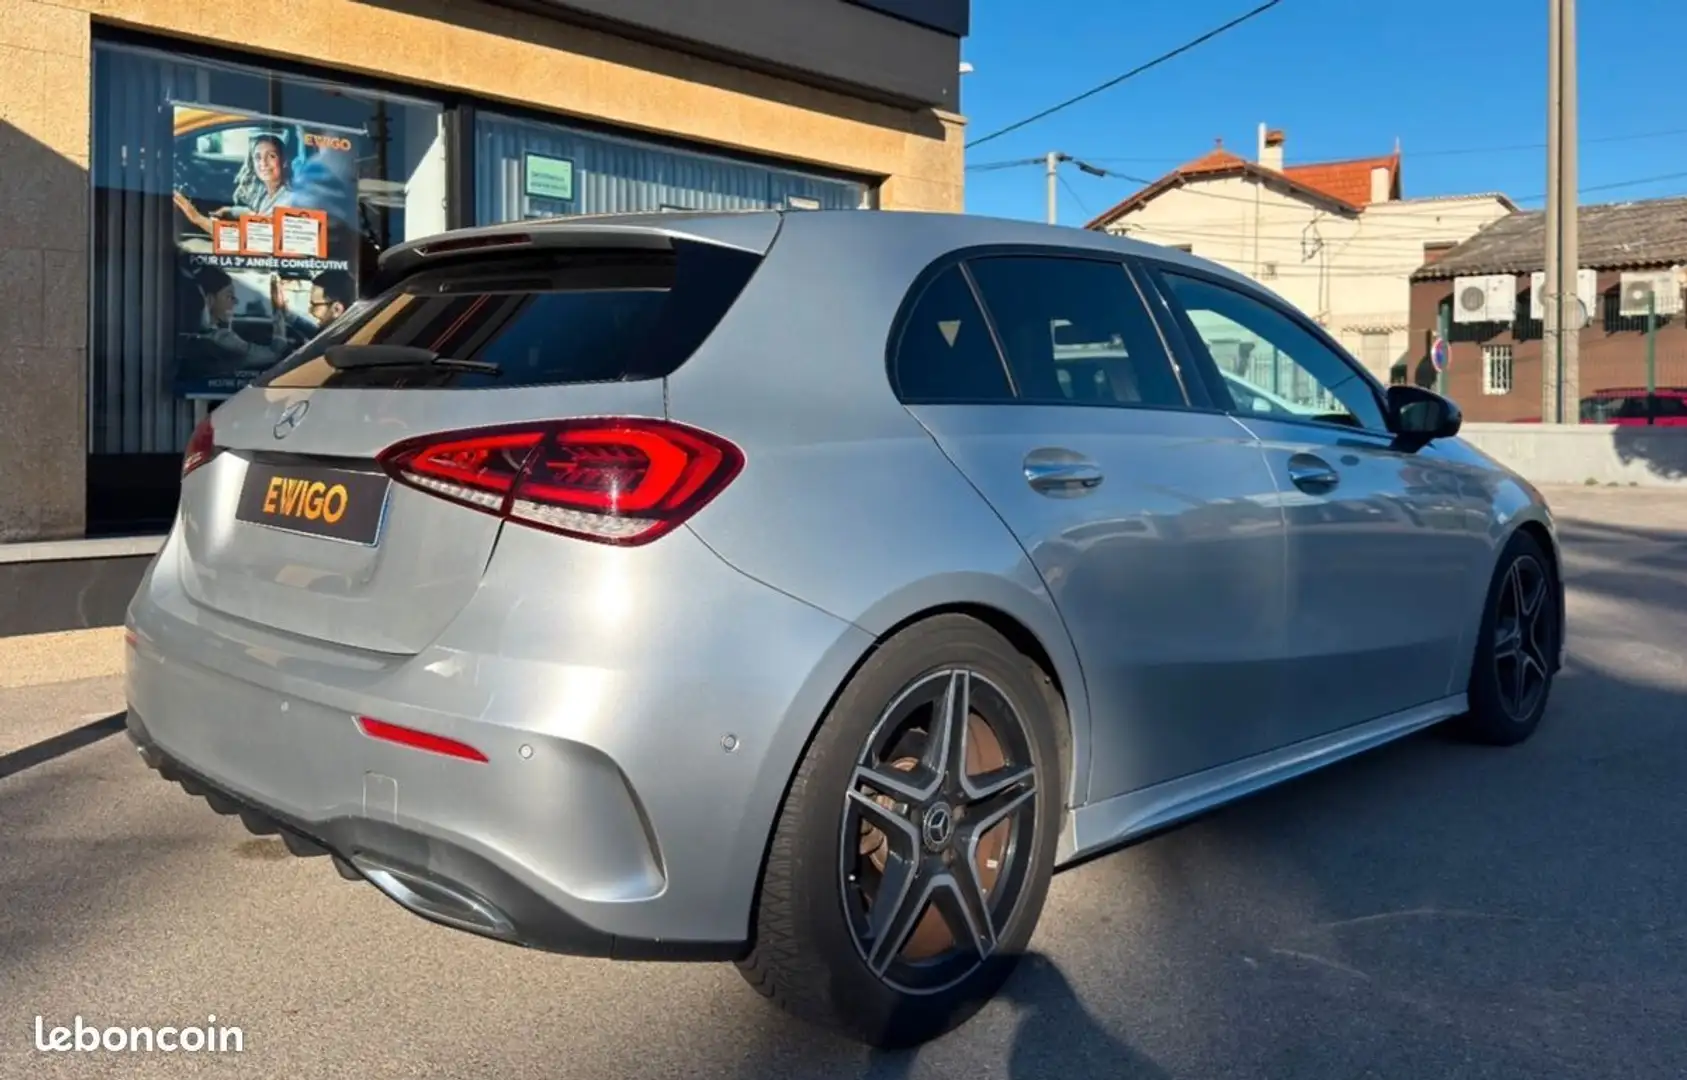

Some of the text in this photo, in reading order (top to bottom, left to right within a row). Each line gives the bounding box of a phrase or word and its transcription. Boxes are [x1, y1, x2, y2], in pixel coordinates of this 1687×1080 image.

[304, 134, 352, 150] EWIGO
[190, 255, 218, 266] POUR
[220, 256, 232, 266] LA
[246, 256, 279, 268] ANNÉE
[281, 257, 349, 270] CONSÉCUTIVE
[263, 476, 348, 523] EWIGO
